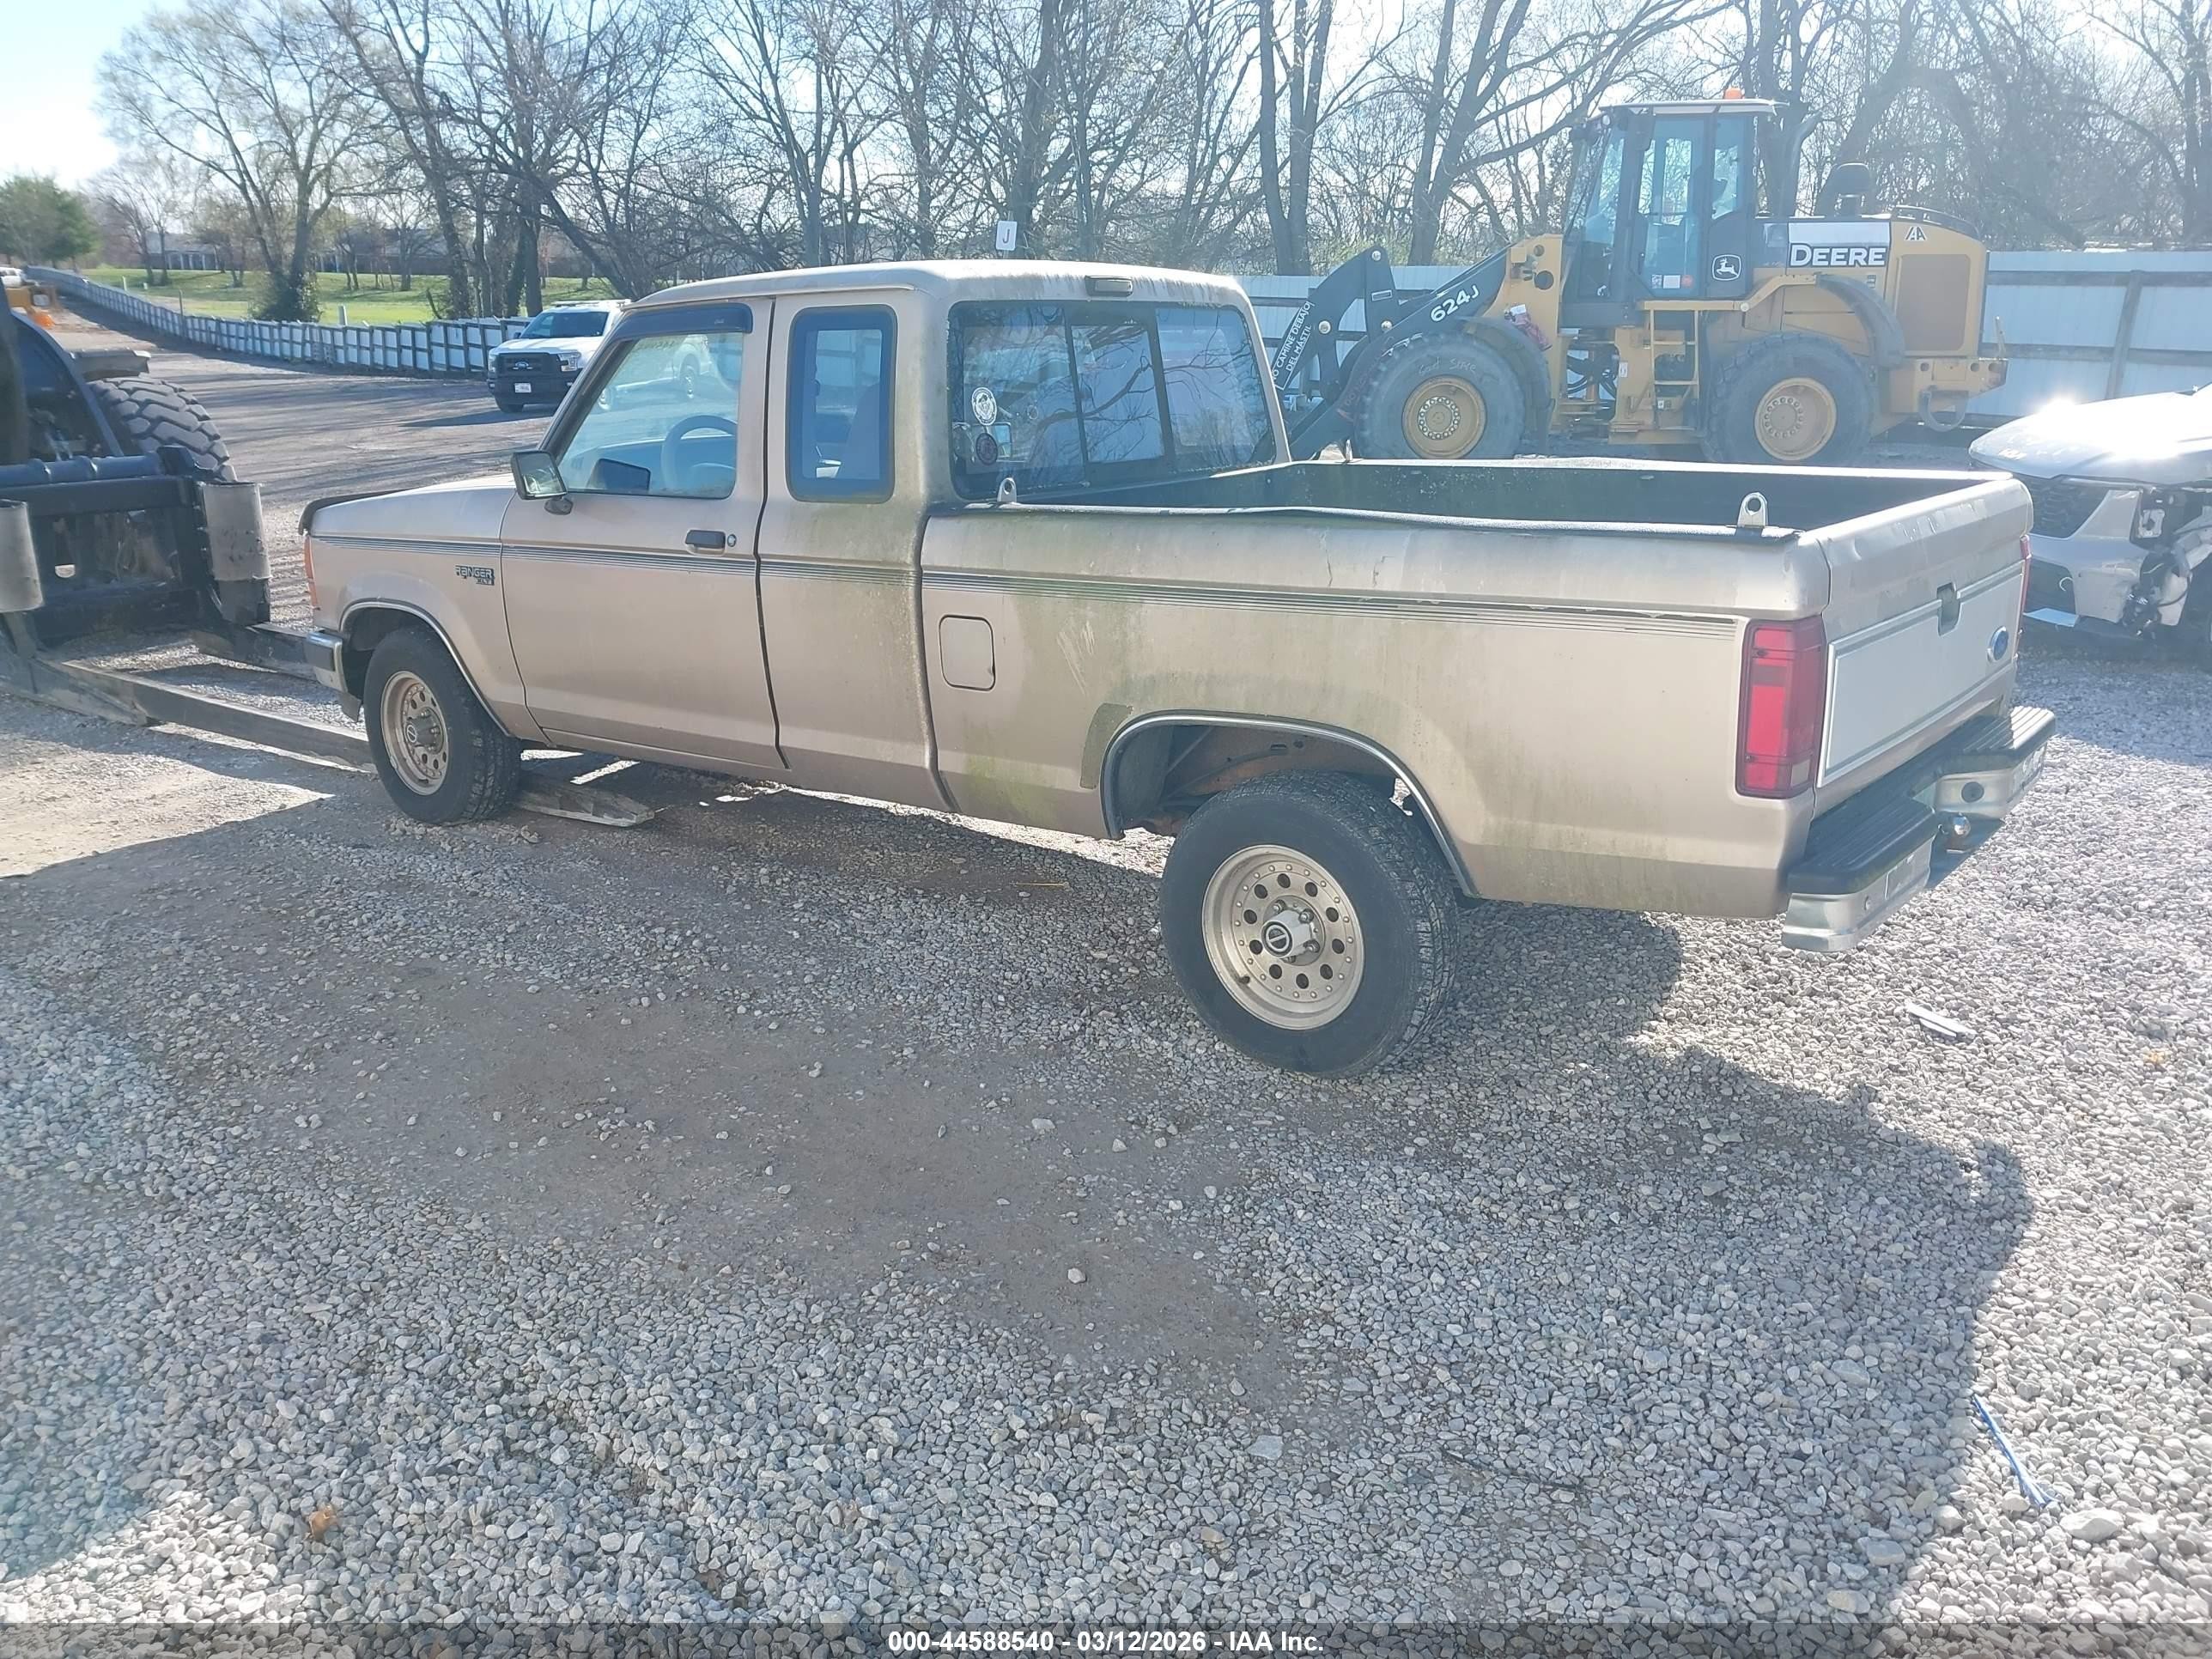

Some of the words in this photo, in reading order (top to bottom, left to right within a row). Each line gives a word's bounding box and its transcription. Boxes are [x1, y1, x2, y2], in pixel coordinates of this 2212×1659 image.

[1001, 228, 1011, 244] J
[1789, 242, 1887, 267] DEERE
[1430, 283, 1480, 322] 624J
[1276, 335, 1296, 368] CAMINE
[1291, 302, 1310, 335] DEBAJO
[1285, 356, 1298, 371] DEL
[453, 564, 495, 579] RANGER
